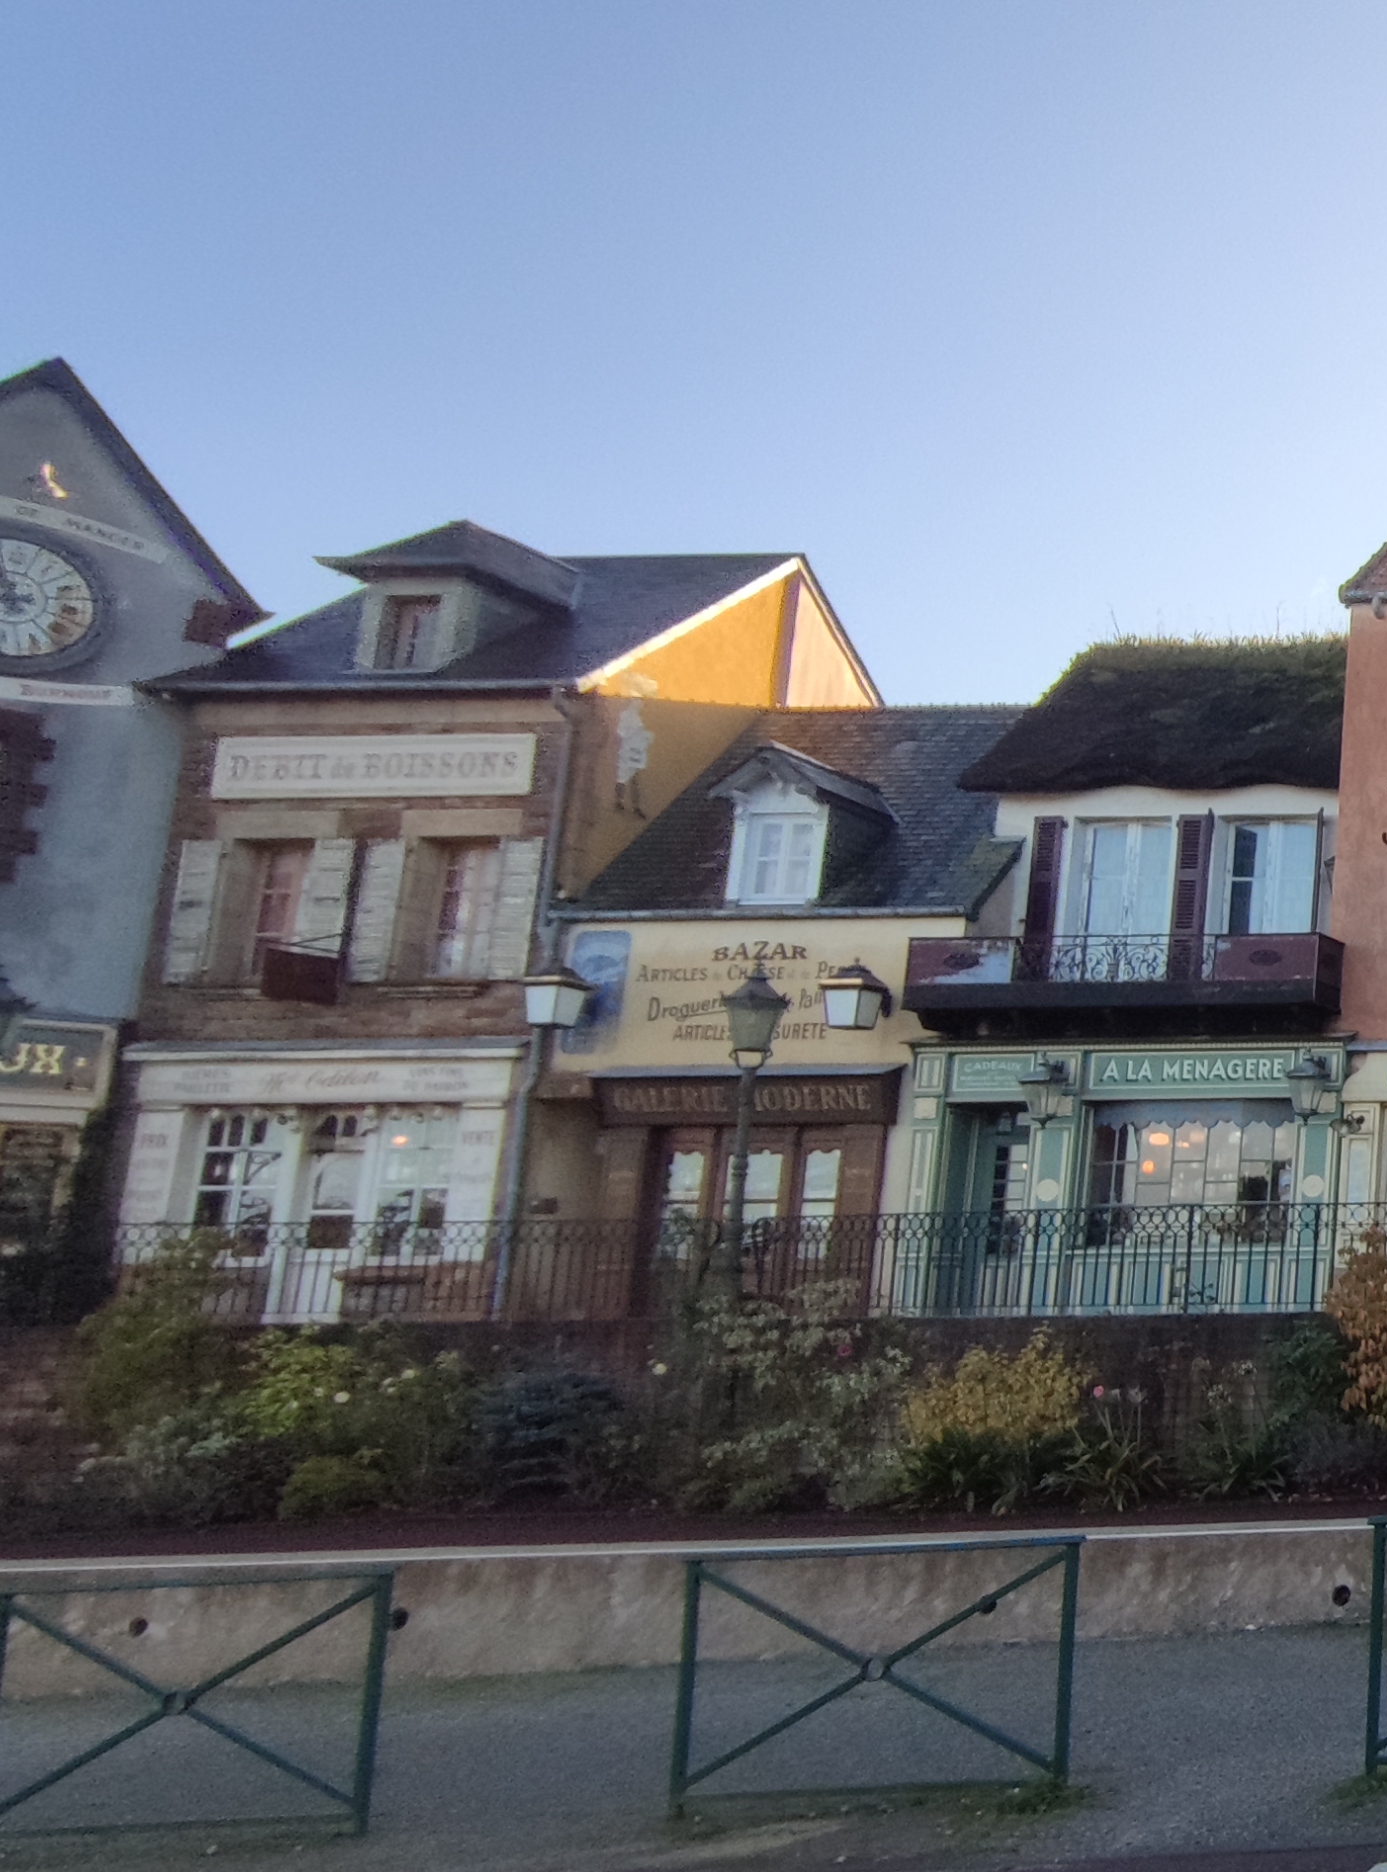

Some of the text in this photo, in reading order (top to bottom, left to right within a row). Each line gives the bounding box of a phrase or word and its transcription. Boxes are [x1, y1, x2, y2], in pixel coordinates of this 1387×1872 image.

[228, 754, 326, 780] DEBIT
[362, 751, 518, 779] BOISSONS
[712, 941, 807, 961] BAZAR
[636, 965, 708, 982] ARTICLES
[963, 1061, 1022, 1073] CADEAUX
[1101, 1057, 1285, 1082] A LA MENAGERE
[613, 1086, 729, 1113] GALERIE
